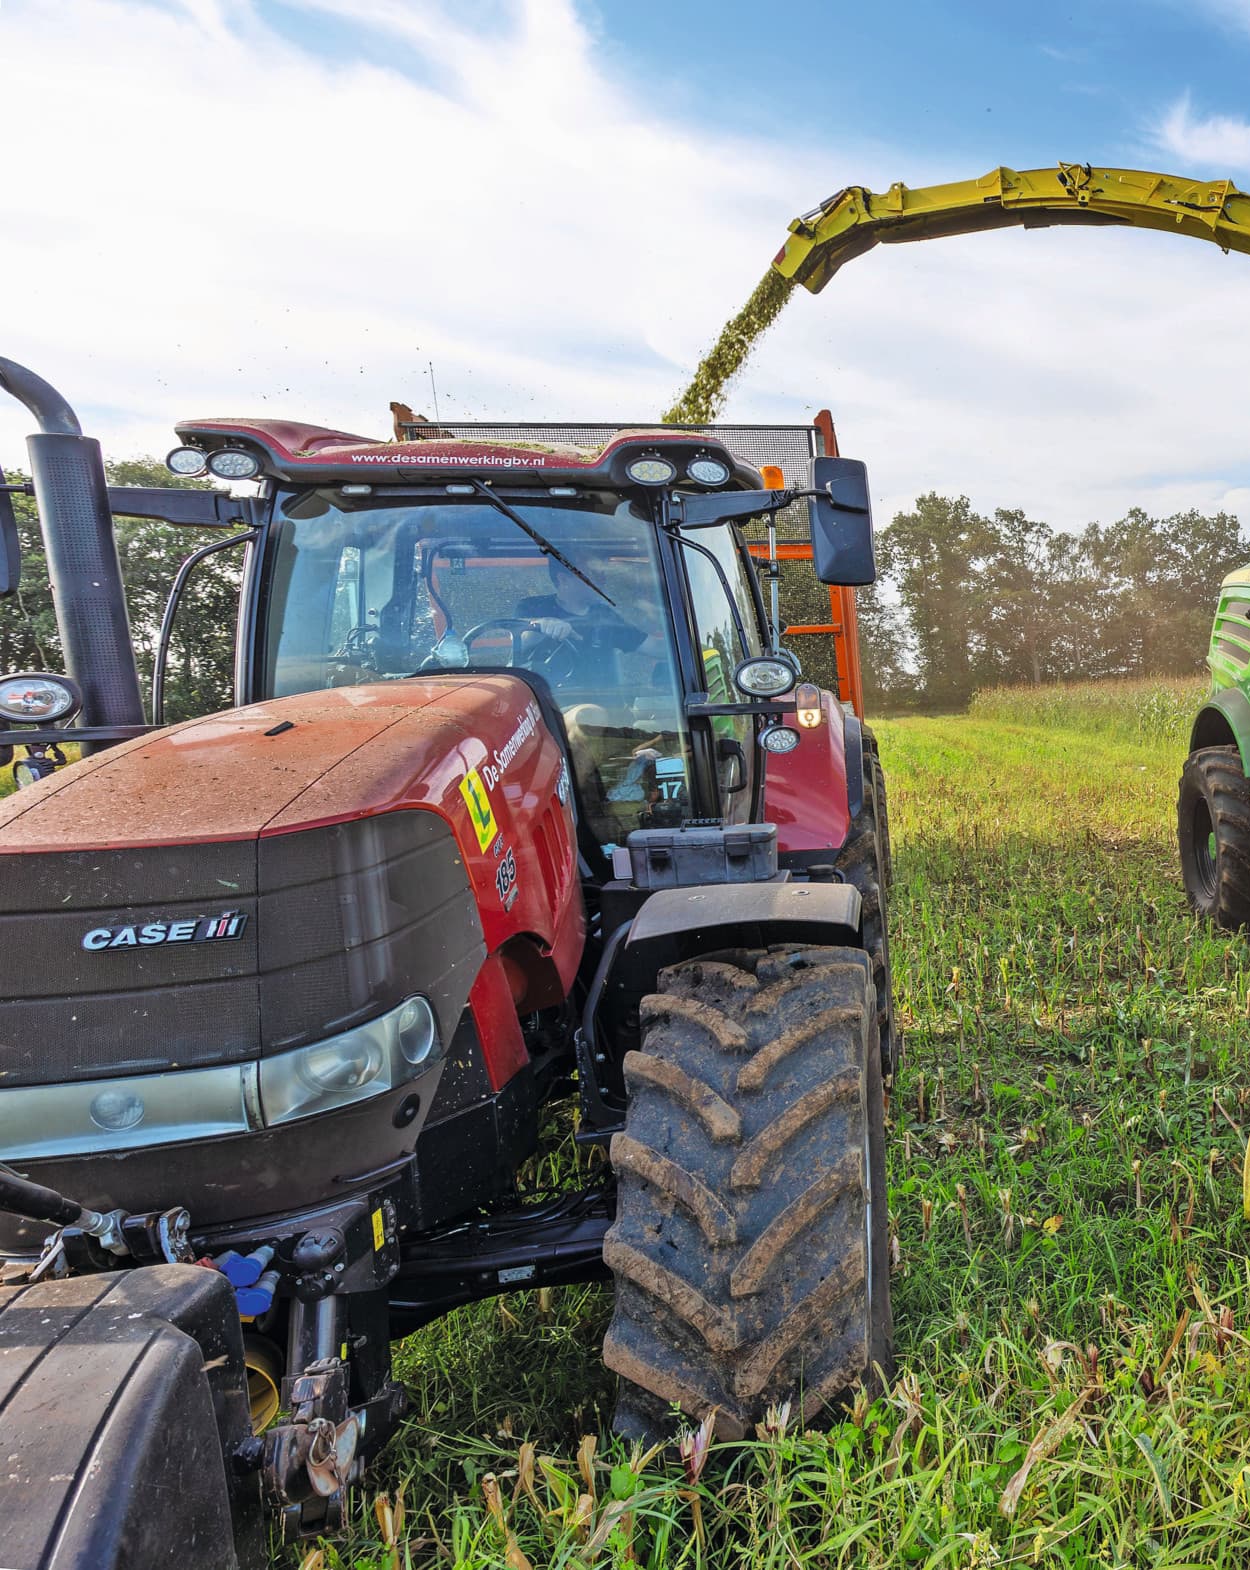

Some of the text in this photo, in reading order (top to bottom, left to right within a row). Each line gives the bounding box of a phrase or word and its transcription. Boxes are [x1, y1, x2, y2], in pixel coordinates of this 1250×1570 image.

[351, 453, 545, 467] www.desamenwerkingbv.nl
[482, 765, 499, 792] De
[657, 781, 682, 800] 17
[495, 846, 516, 900] 185
[83, 920, 196, 951] CASE
